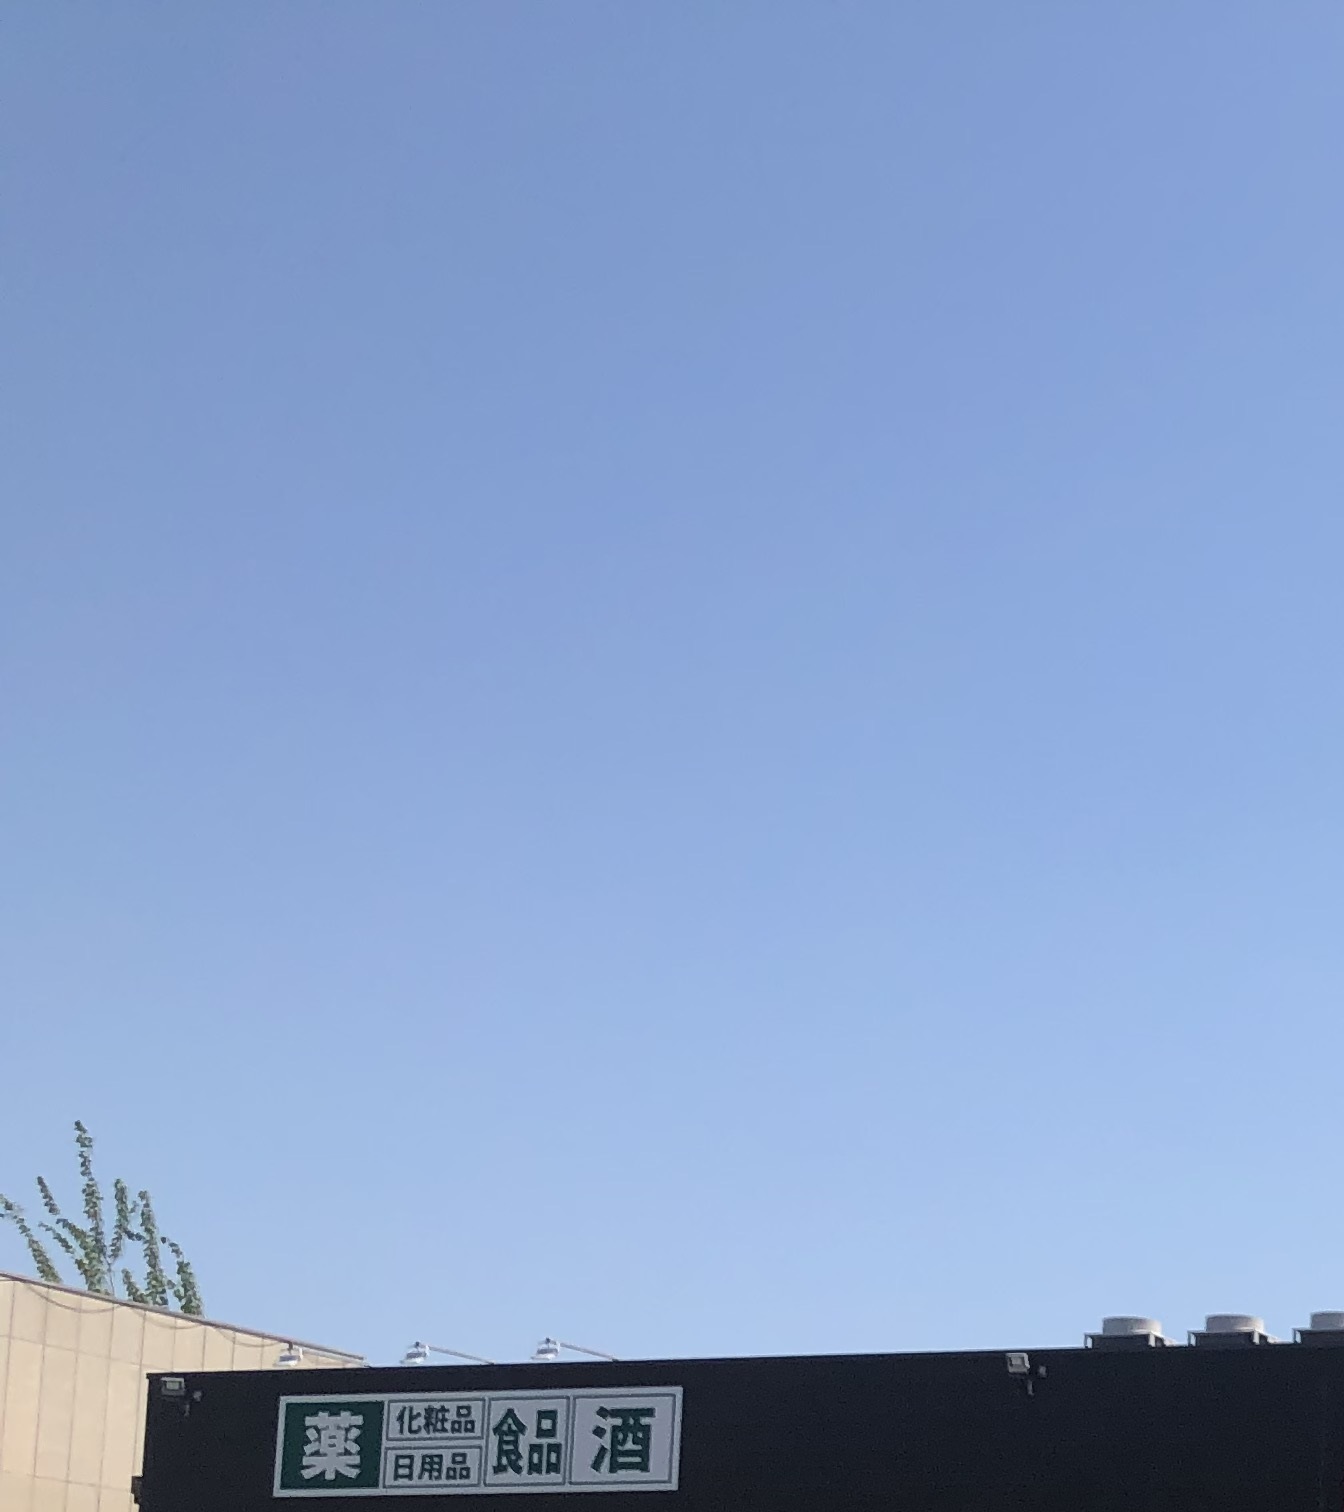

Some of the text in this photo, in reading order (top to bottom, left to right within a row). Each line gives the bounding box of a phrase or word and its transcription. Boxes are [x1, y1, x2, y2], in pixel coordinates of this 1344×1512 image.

[302, 1410, 365, 1481] 薬
[396, 1404, 476, 1436] 化粧品
[492, 1408, 563, 1475] 食品
[591, 1406, 656, 1473] 酒
[392, 1452, 473, 1483] 日用品
